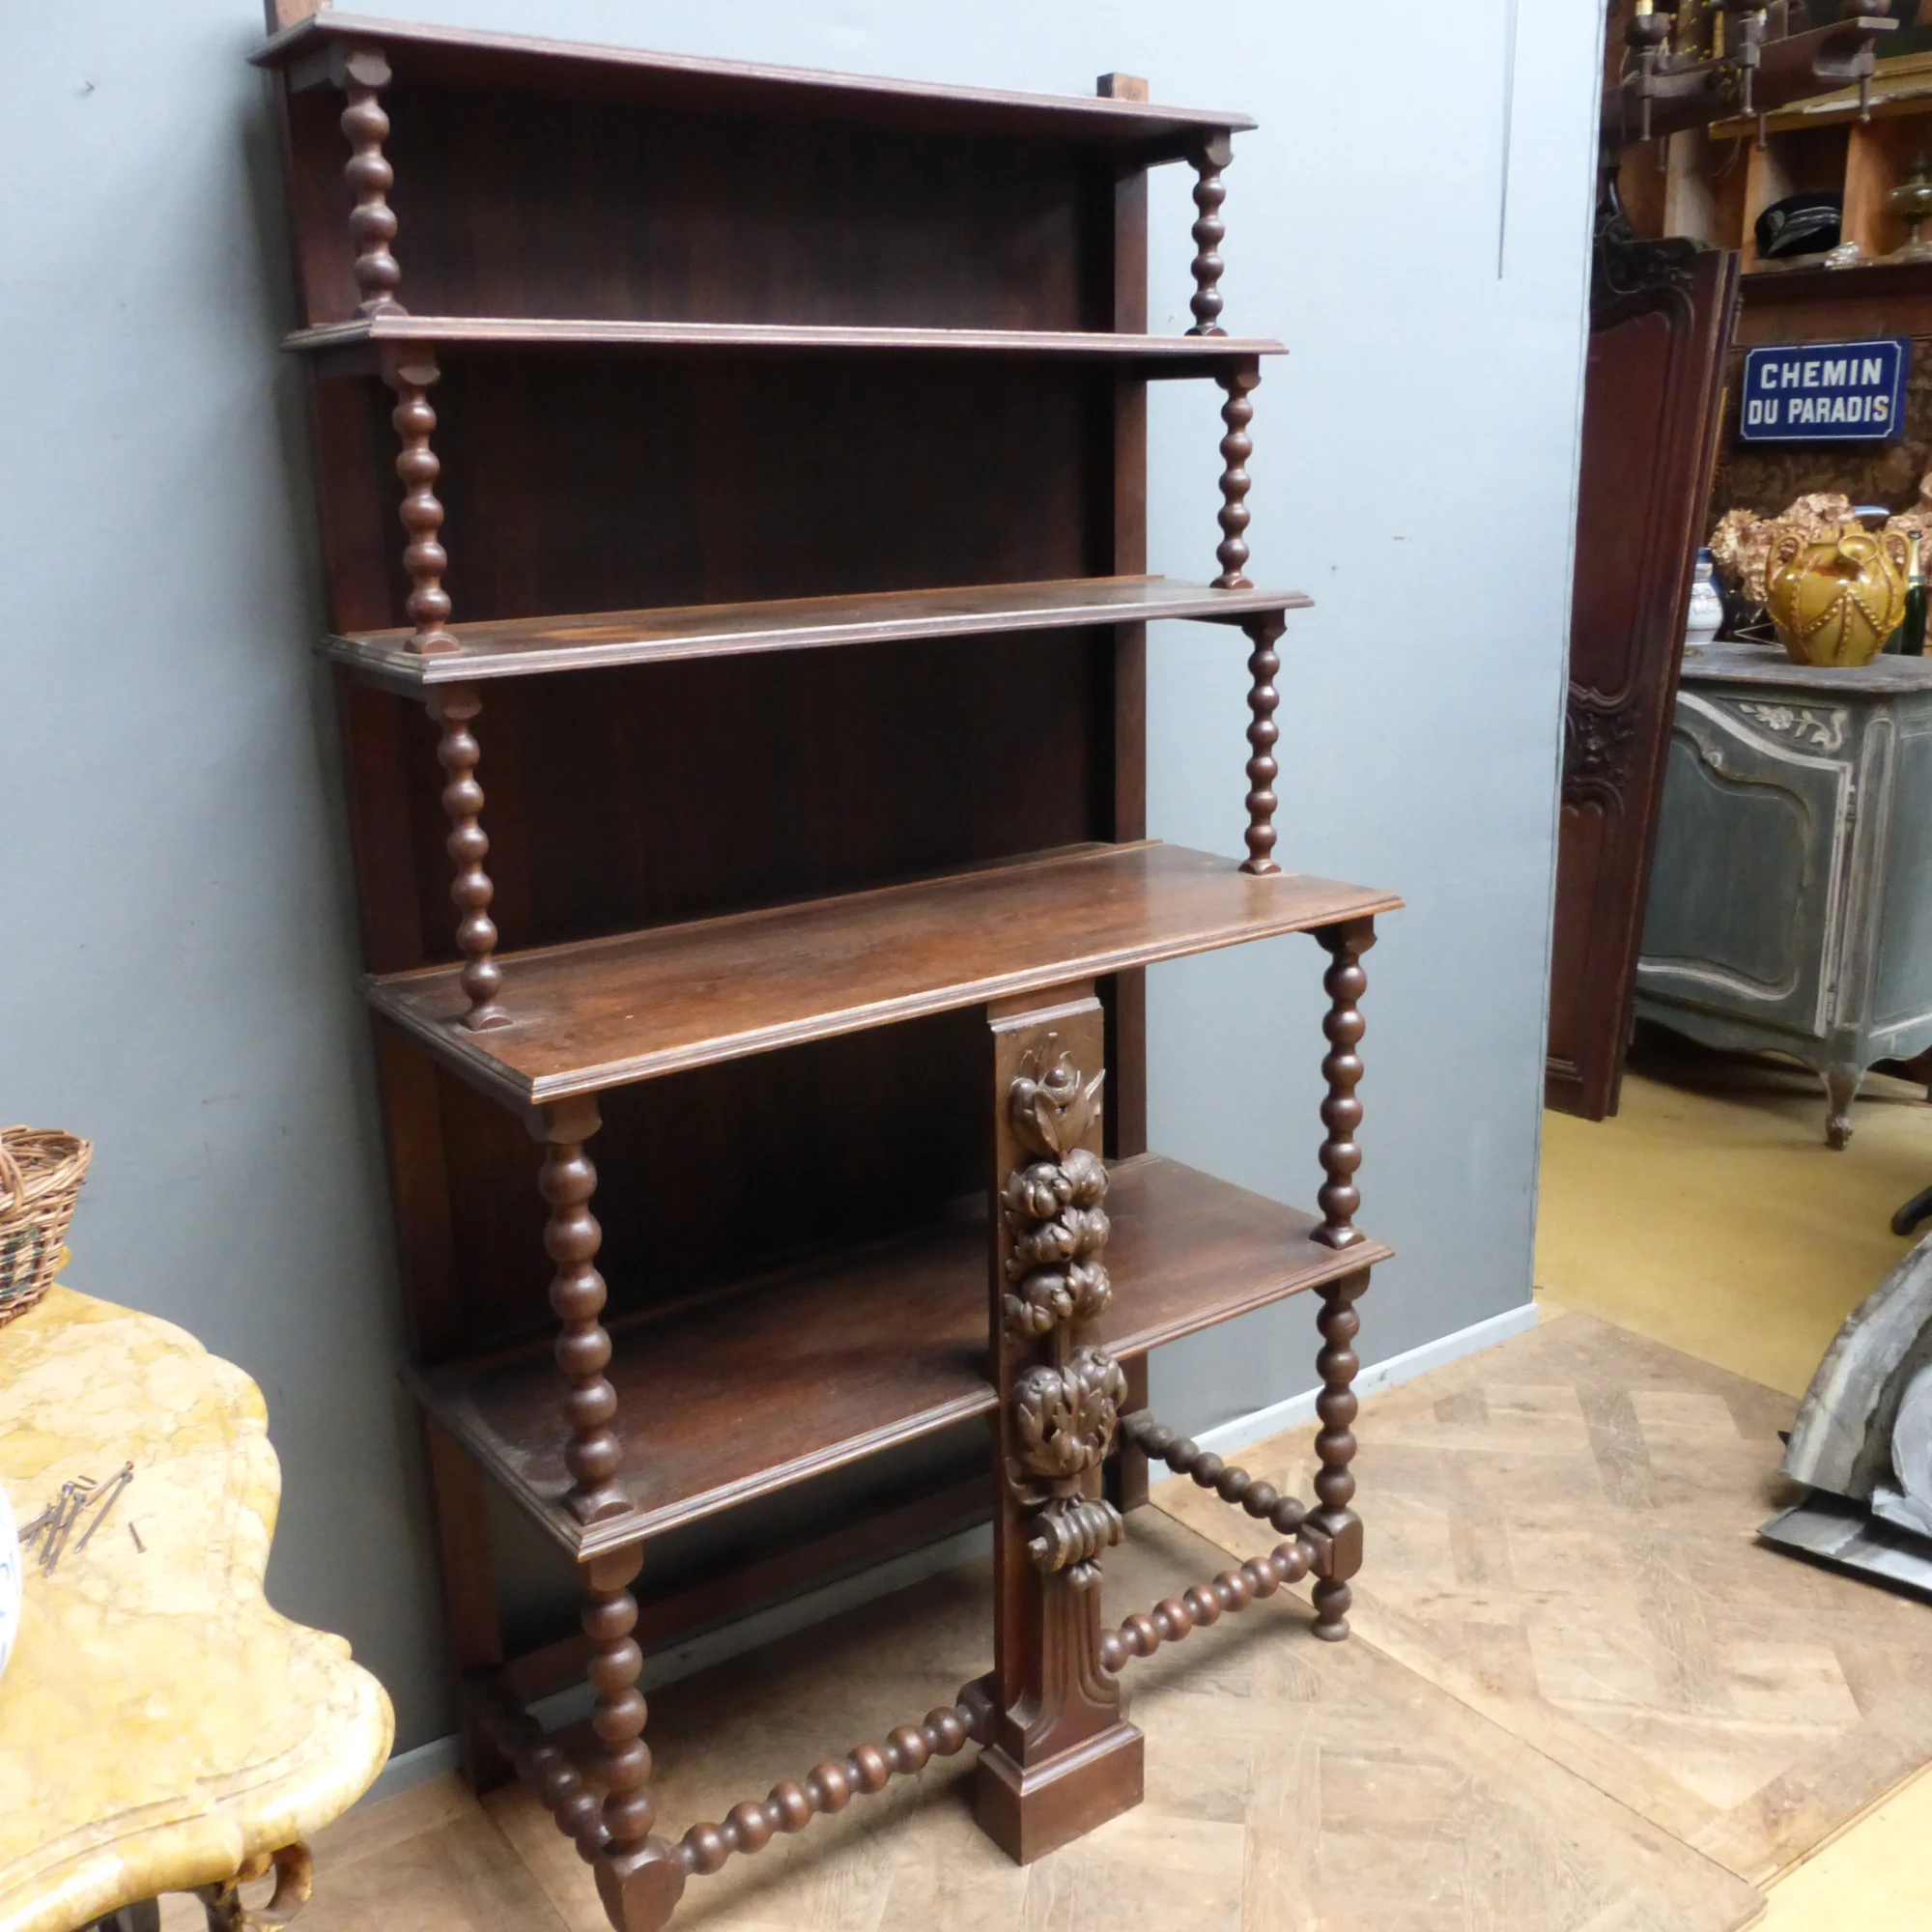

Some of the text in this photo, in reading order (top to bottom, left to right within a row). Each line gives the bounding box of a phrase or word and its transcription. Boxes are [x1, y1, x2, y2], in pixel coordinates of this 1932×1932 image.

[1760, 357, 1882, 389] CHEMIN
[1747, 395, 1889, 425] DU PARADIS
